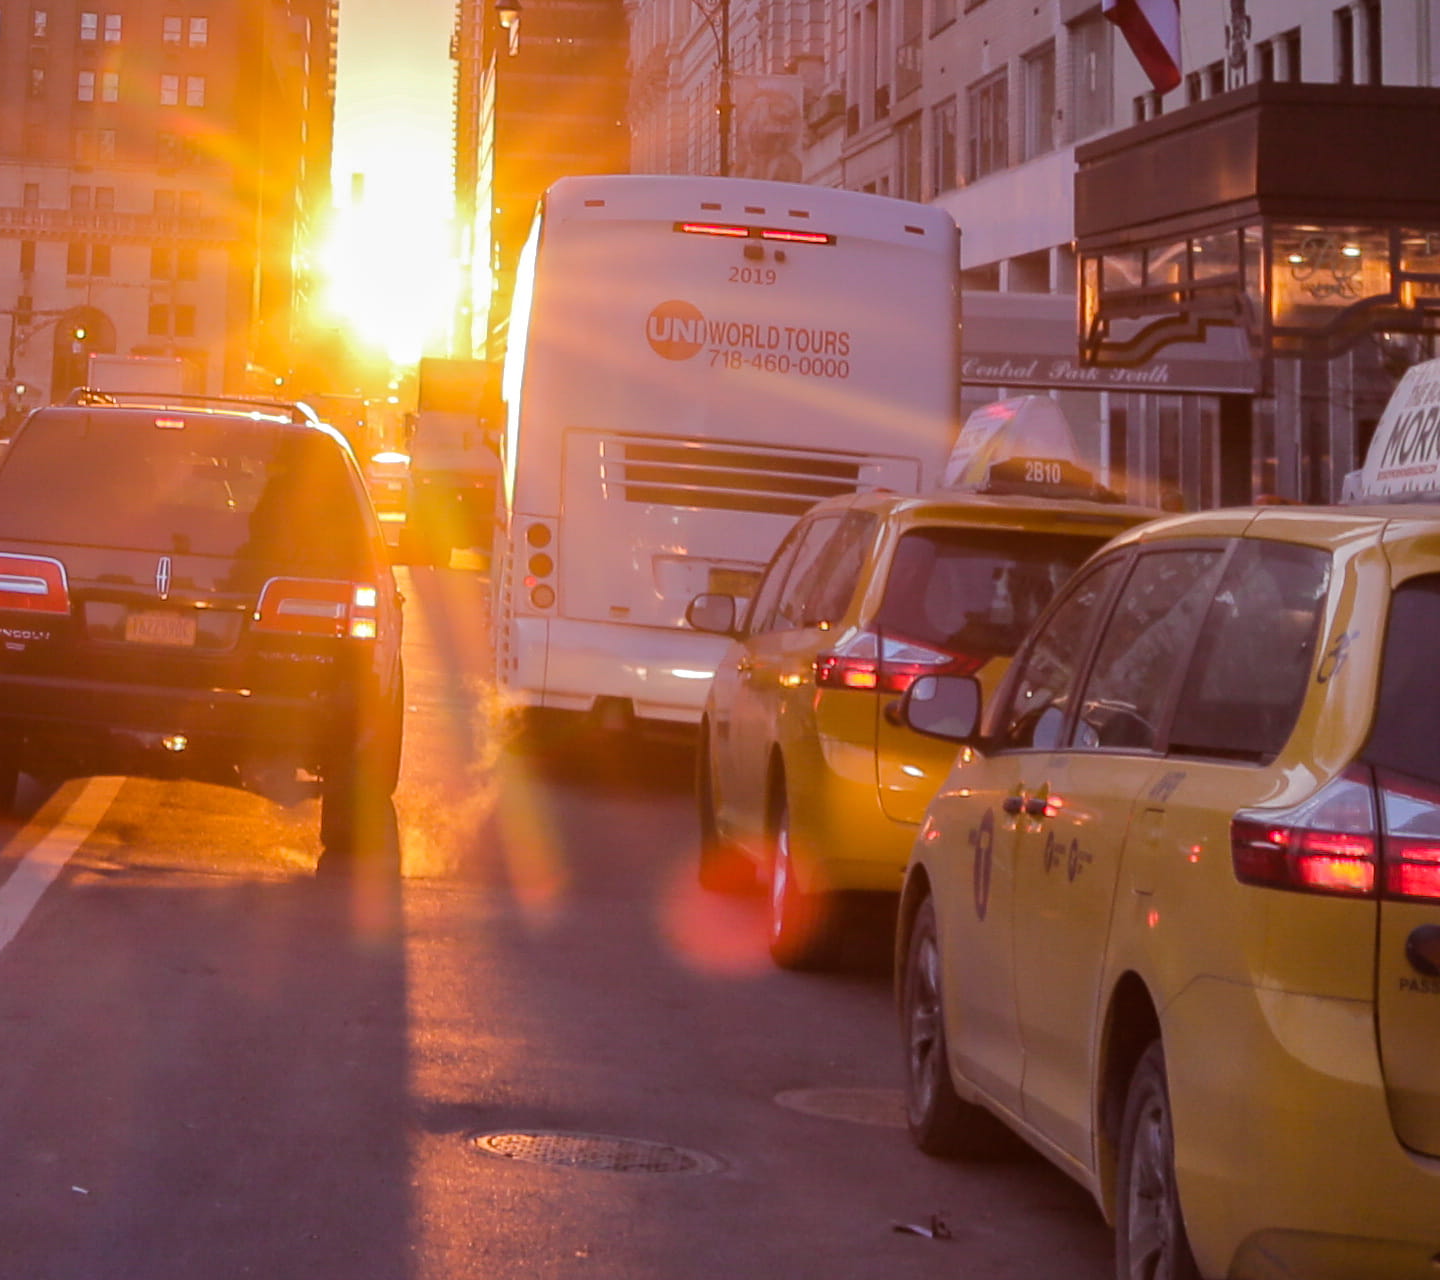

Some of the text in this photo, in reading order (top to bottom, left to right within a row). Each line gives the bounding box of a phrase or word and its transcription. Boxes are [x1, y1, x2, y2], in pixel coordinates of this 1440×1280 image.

[728, 266, 777, 285] 2019
[708, 320, 780, 350] WORLD
[784, 326, 851, 357] TOURS
[709, 349, 851, 379] 718-460-0000
[962, 357, 1038, 380] Central
[1049, 359, 1098, 381] Park
[1025, 460, 1062, 485] 2B10
